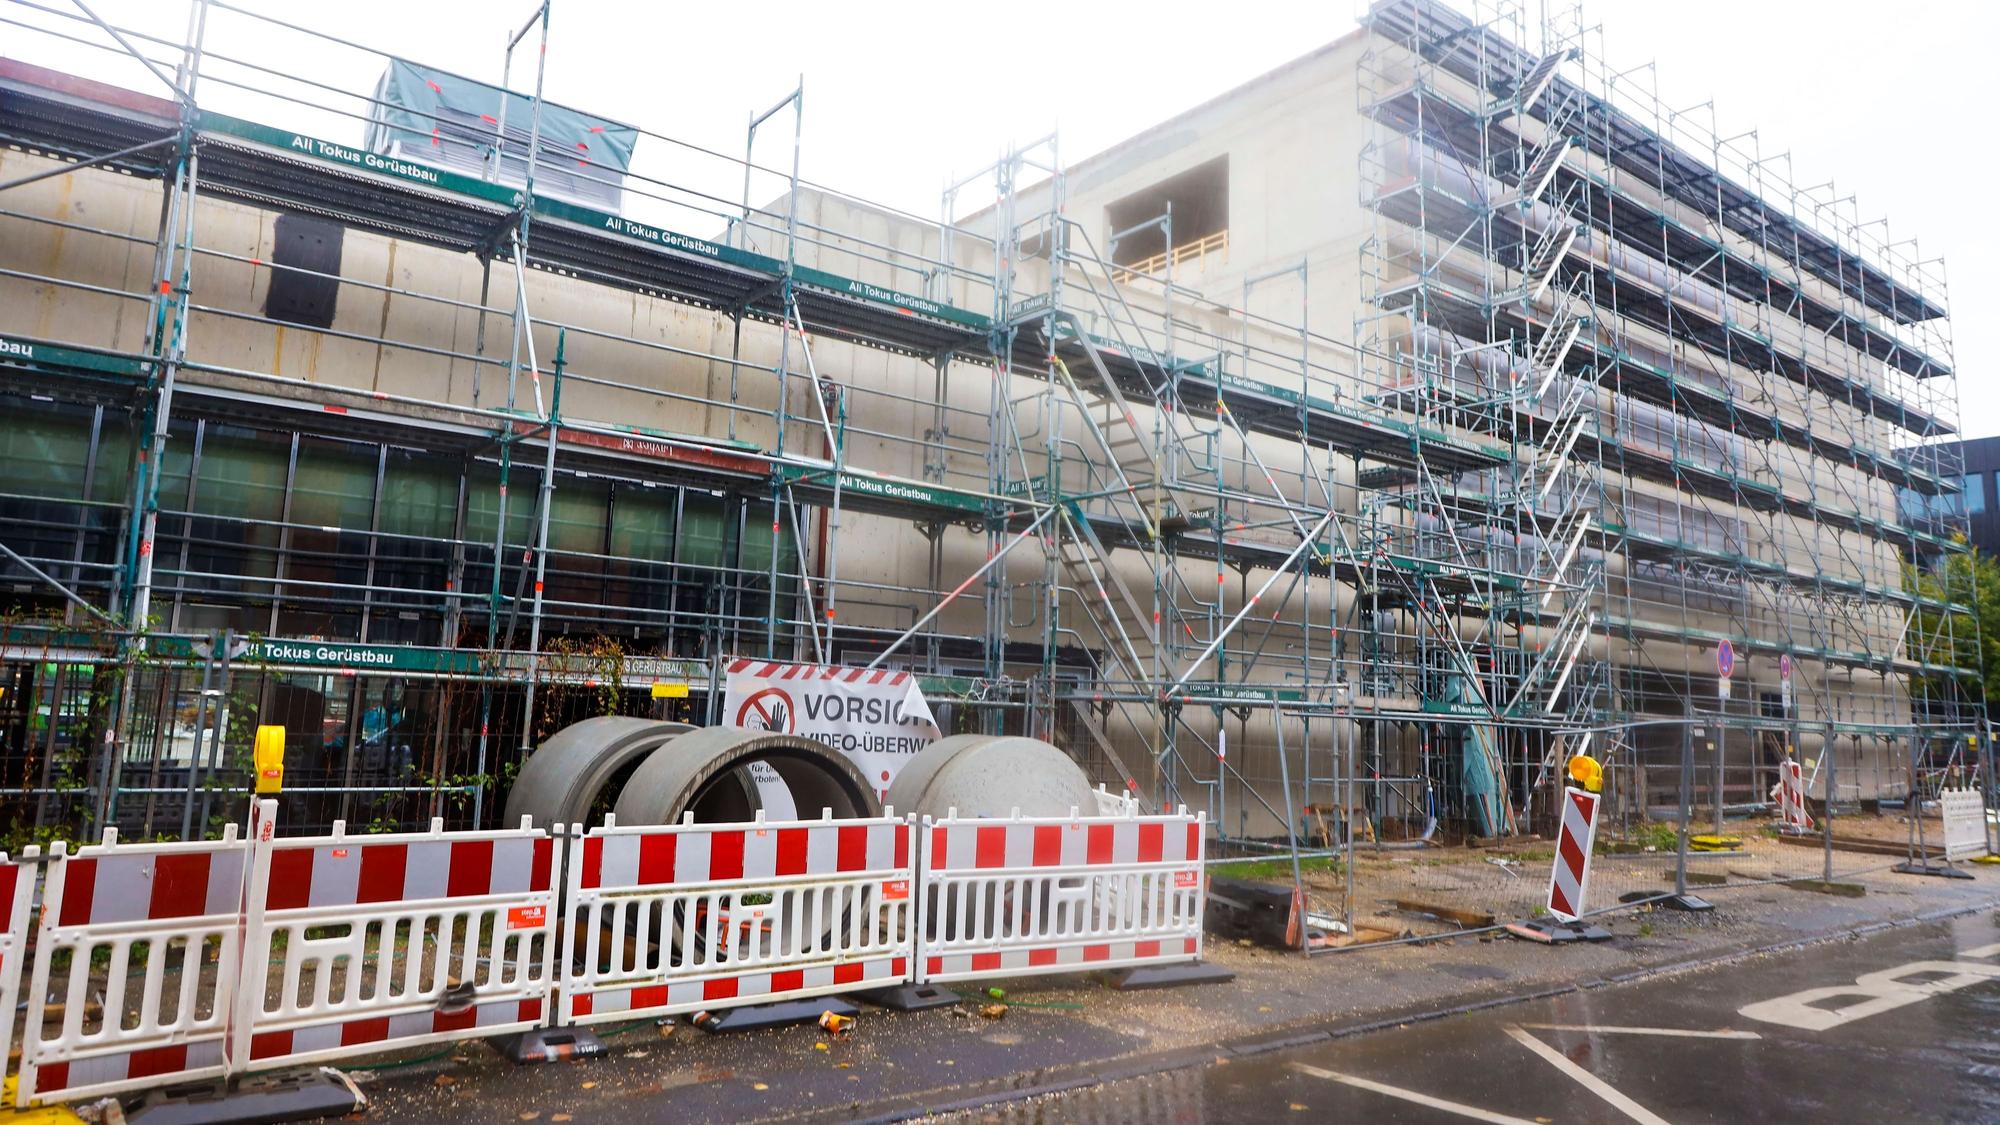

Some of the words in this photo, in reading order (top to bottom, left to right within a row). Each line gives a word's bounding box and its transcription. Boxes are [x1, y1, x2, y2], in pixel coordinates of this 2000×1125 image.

[316, 141, 361, 163] Tokus
[365, 154, 438, 183] Gerüstbau
[625, 221, 659, 240] Tokus
[661, 231, 719, 256] Gerüstbau
[864, 285, 891, 301] Tokus
[893, 293, 939, 313] Gerüstbau
[855, 478, 883, 493] Tokus
[885, 484, 931, 501] Gerüstbau
[265, 644, 311, 660] Tokus
[316, 647, 393, 663] Gerüstbau
[804, 693, 932, 727] VORSIC
